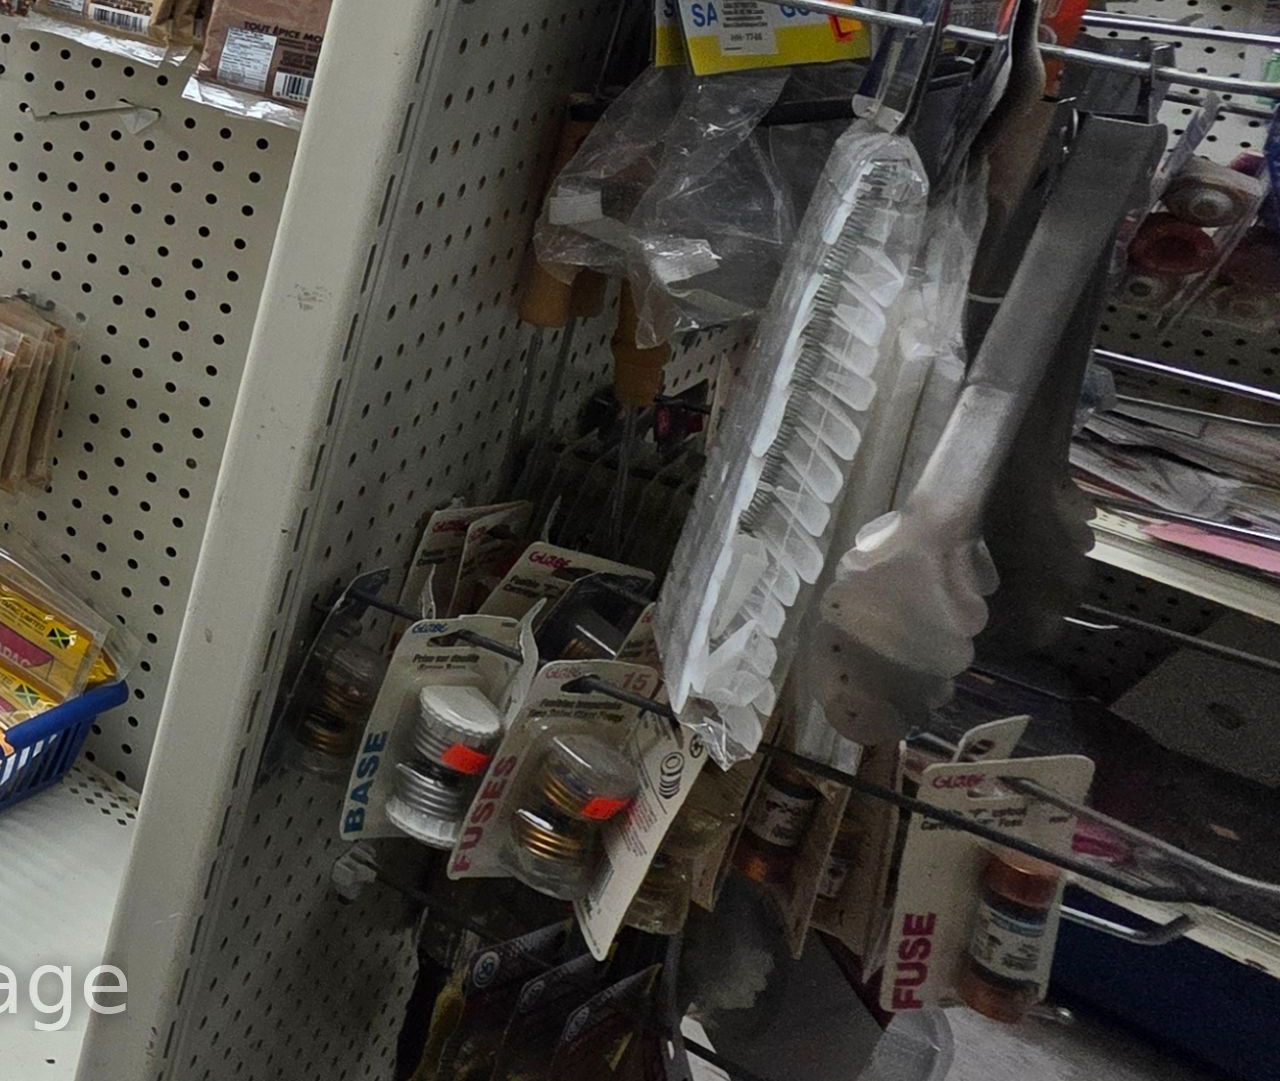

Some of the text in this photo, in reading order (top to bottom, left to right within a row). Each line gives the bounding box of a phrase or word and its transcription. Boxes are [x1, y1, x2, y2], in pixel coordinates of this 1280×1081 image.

[244, 21, 271, 34] TOUT
[272, 24, 300, 40] ÉPICE
[623, 673, 648, 690] 15
[344, 730, 388, 834] BASE
[452, 754, 517, 873] FUSES
[891, 912, 936, 1010] FUSE
